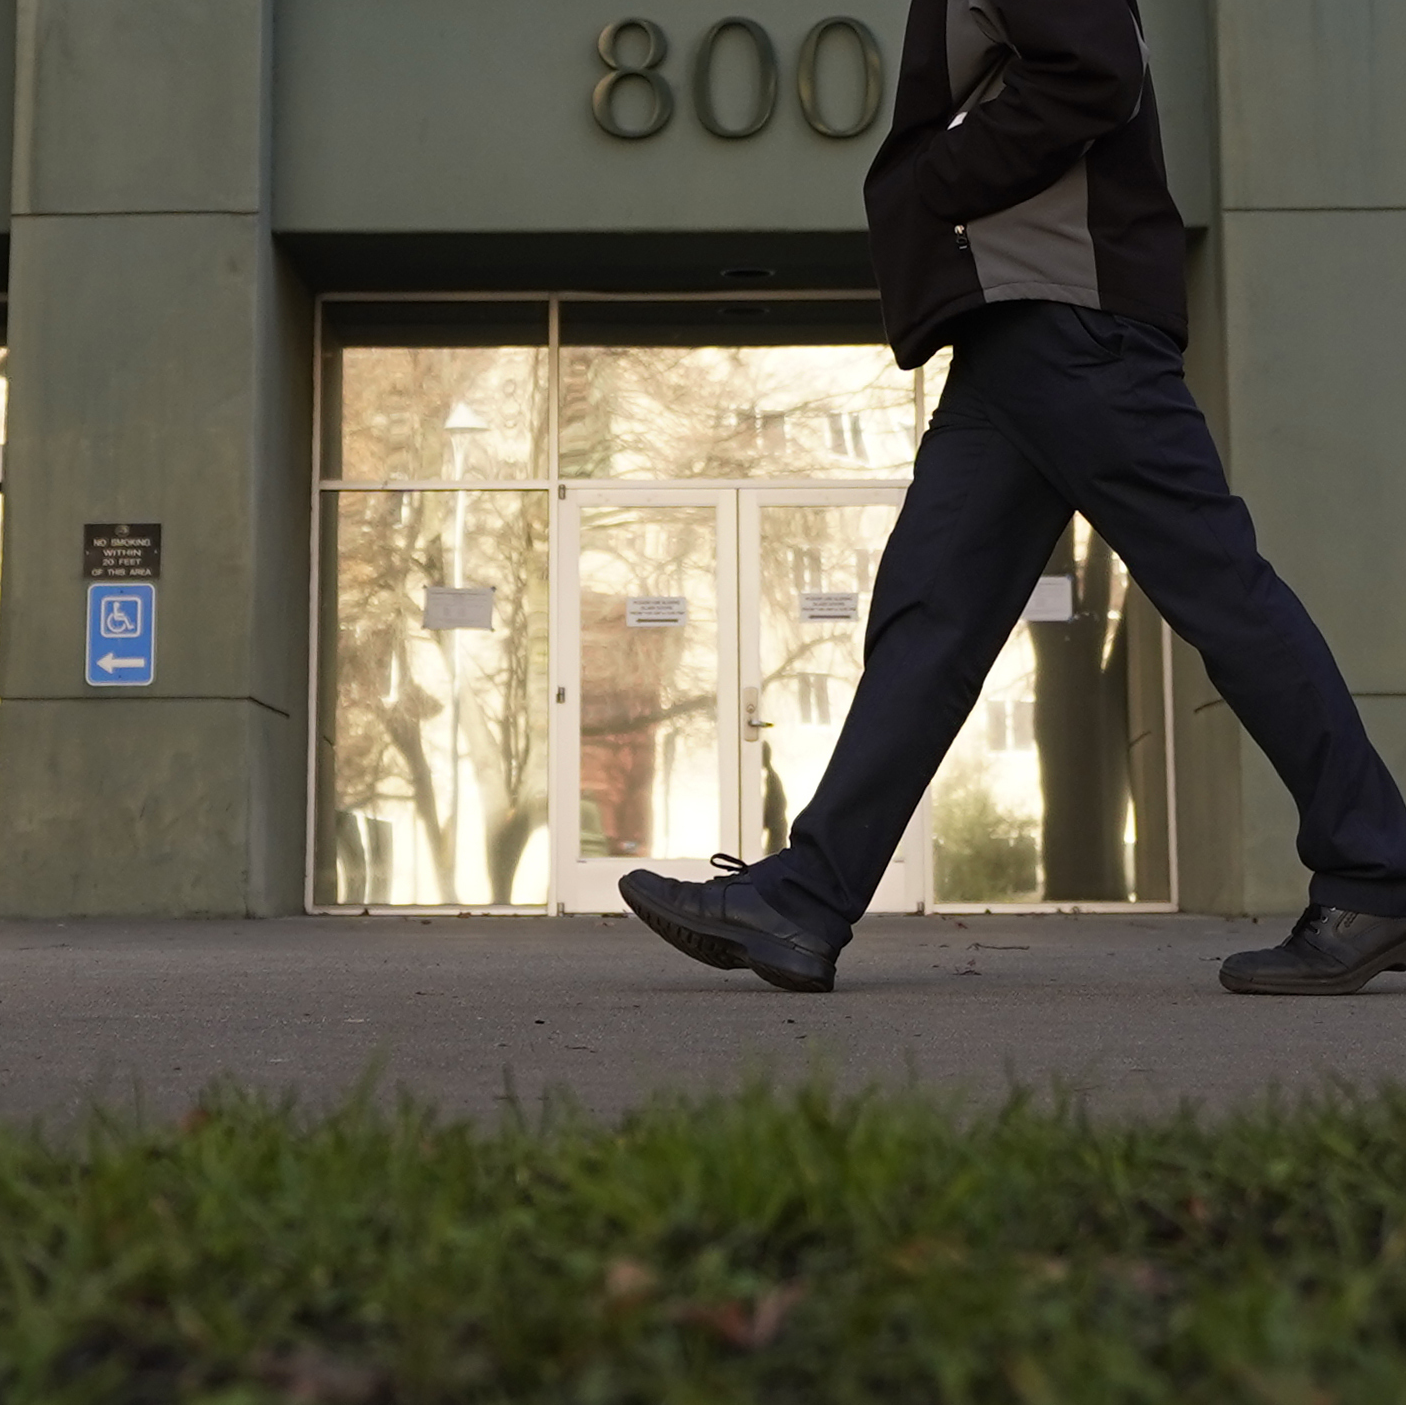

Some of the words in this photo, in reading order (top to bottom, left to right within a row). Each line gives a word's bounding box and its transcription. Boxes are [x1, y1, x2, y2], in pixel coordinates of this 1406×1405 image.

[592, 15, 884, 139] 800
[93, 538, 107, 547] NO
[110, 538, 151, 547] SMOKING
[102, 549, 142, 557] WITHIN
[102, 558, 115, 566] 20
[118, 558, 142, 566] FEET
[91, 568, 104, 576] OF
[107, 568, 126, 576] THIS
[129, 568, 152, 576] AREA
